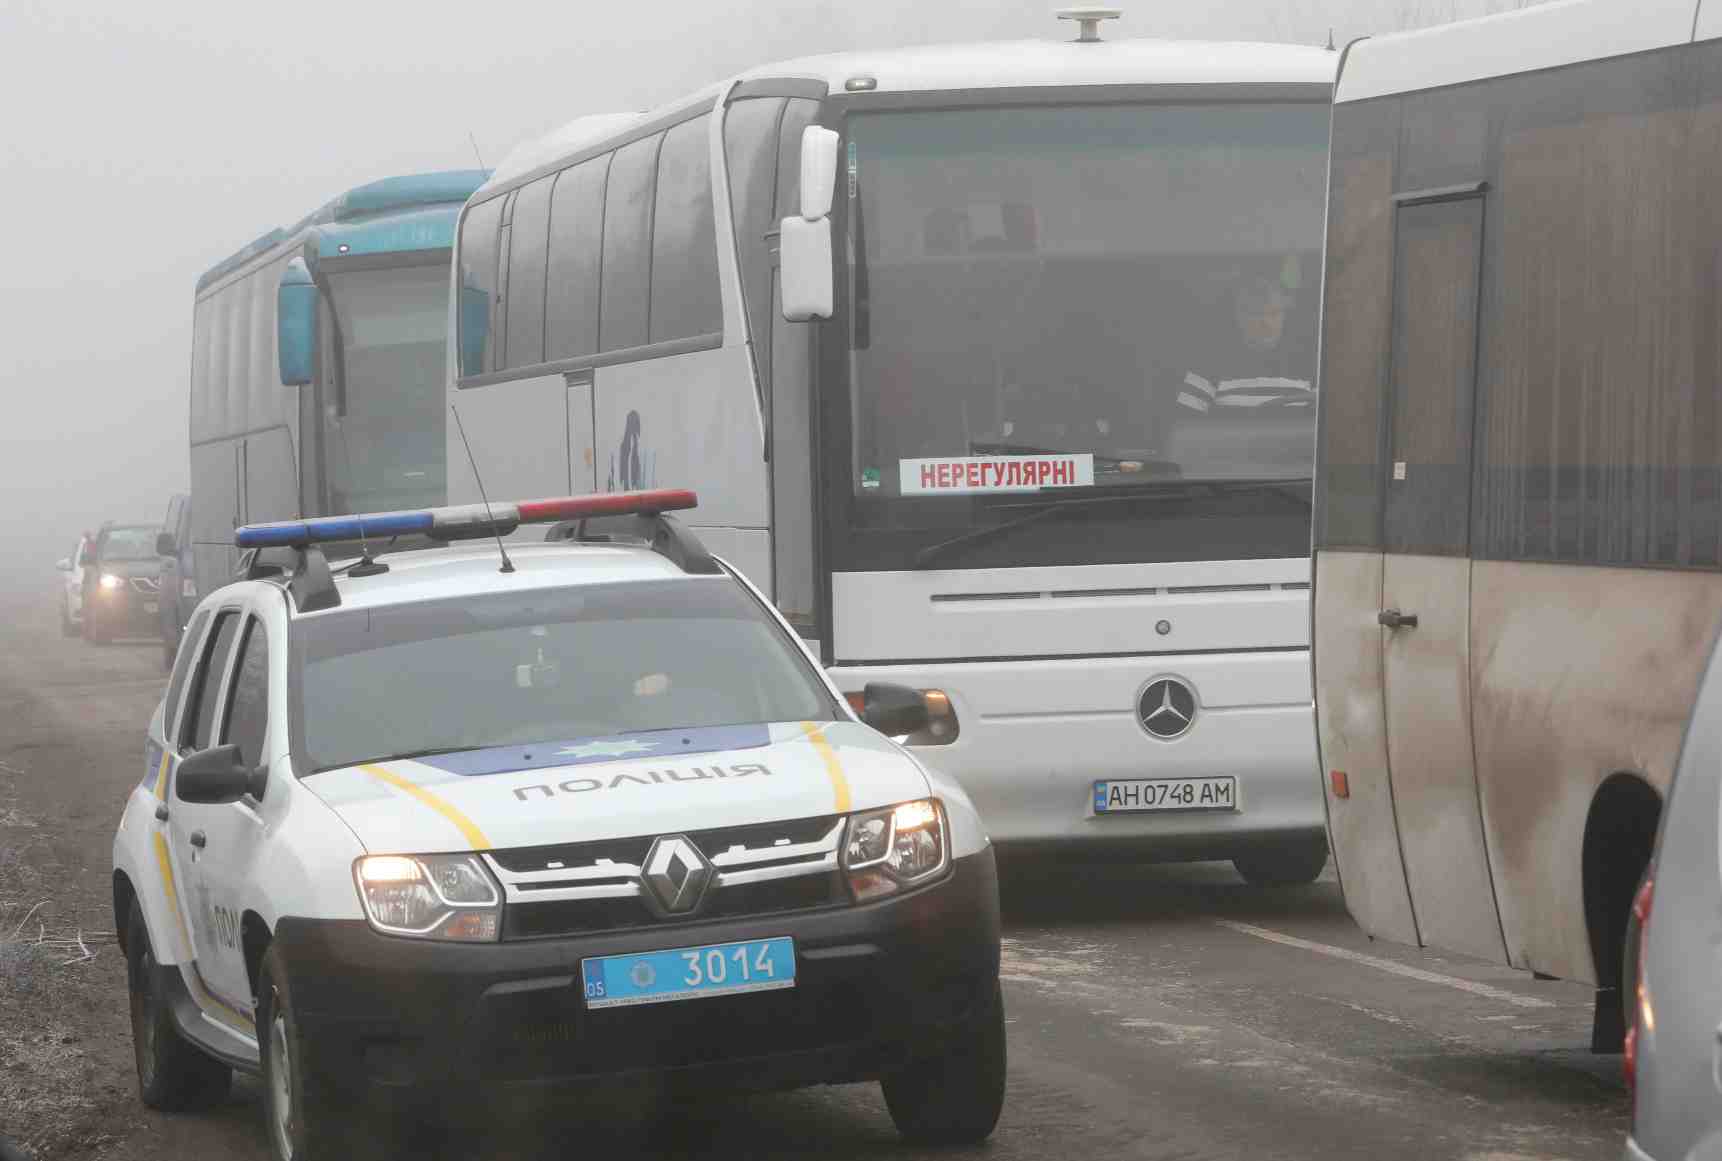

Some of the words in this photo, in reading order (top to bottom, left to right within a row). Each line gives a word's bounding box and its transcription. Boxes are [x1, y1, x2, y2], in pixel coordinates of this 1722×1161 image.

[920, 460, 1075, 488] НЕРЕГУЛЯРНІ
[512, 763, 772, 801] ПОЛІЦІЯ
[1109, 785, 1139, 806] AH
[1144, 783, 1194, 806] 0748
[1200, 782, 1230, 804] AM
[680, 943, 774, 986] 3014
